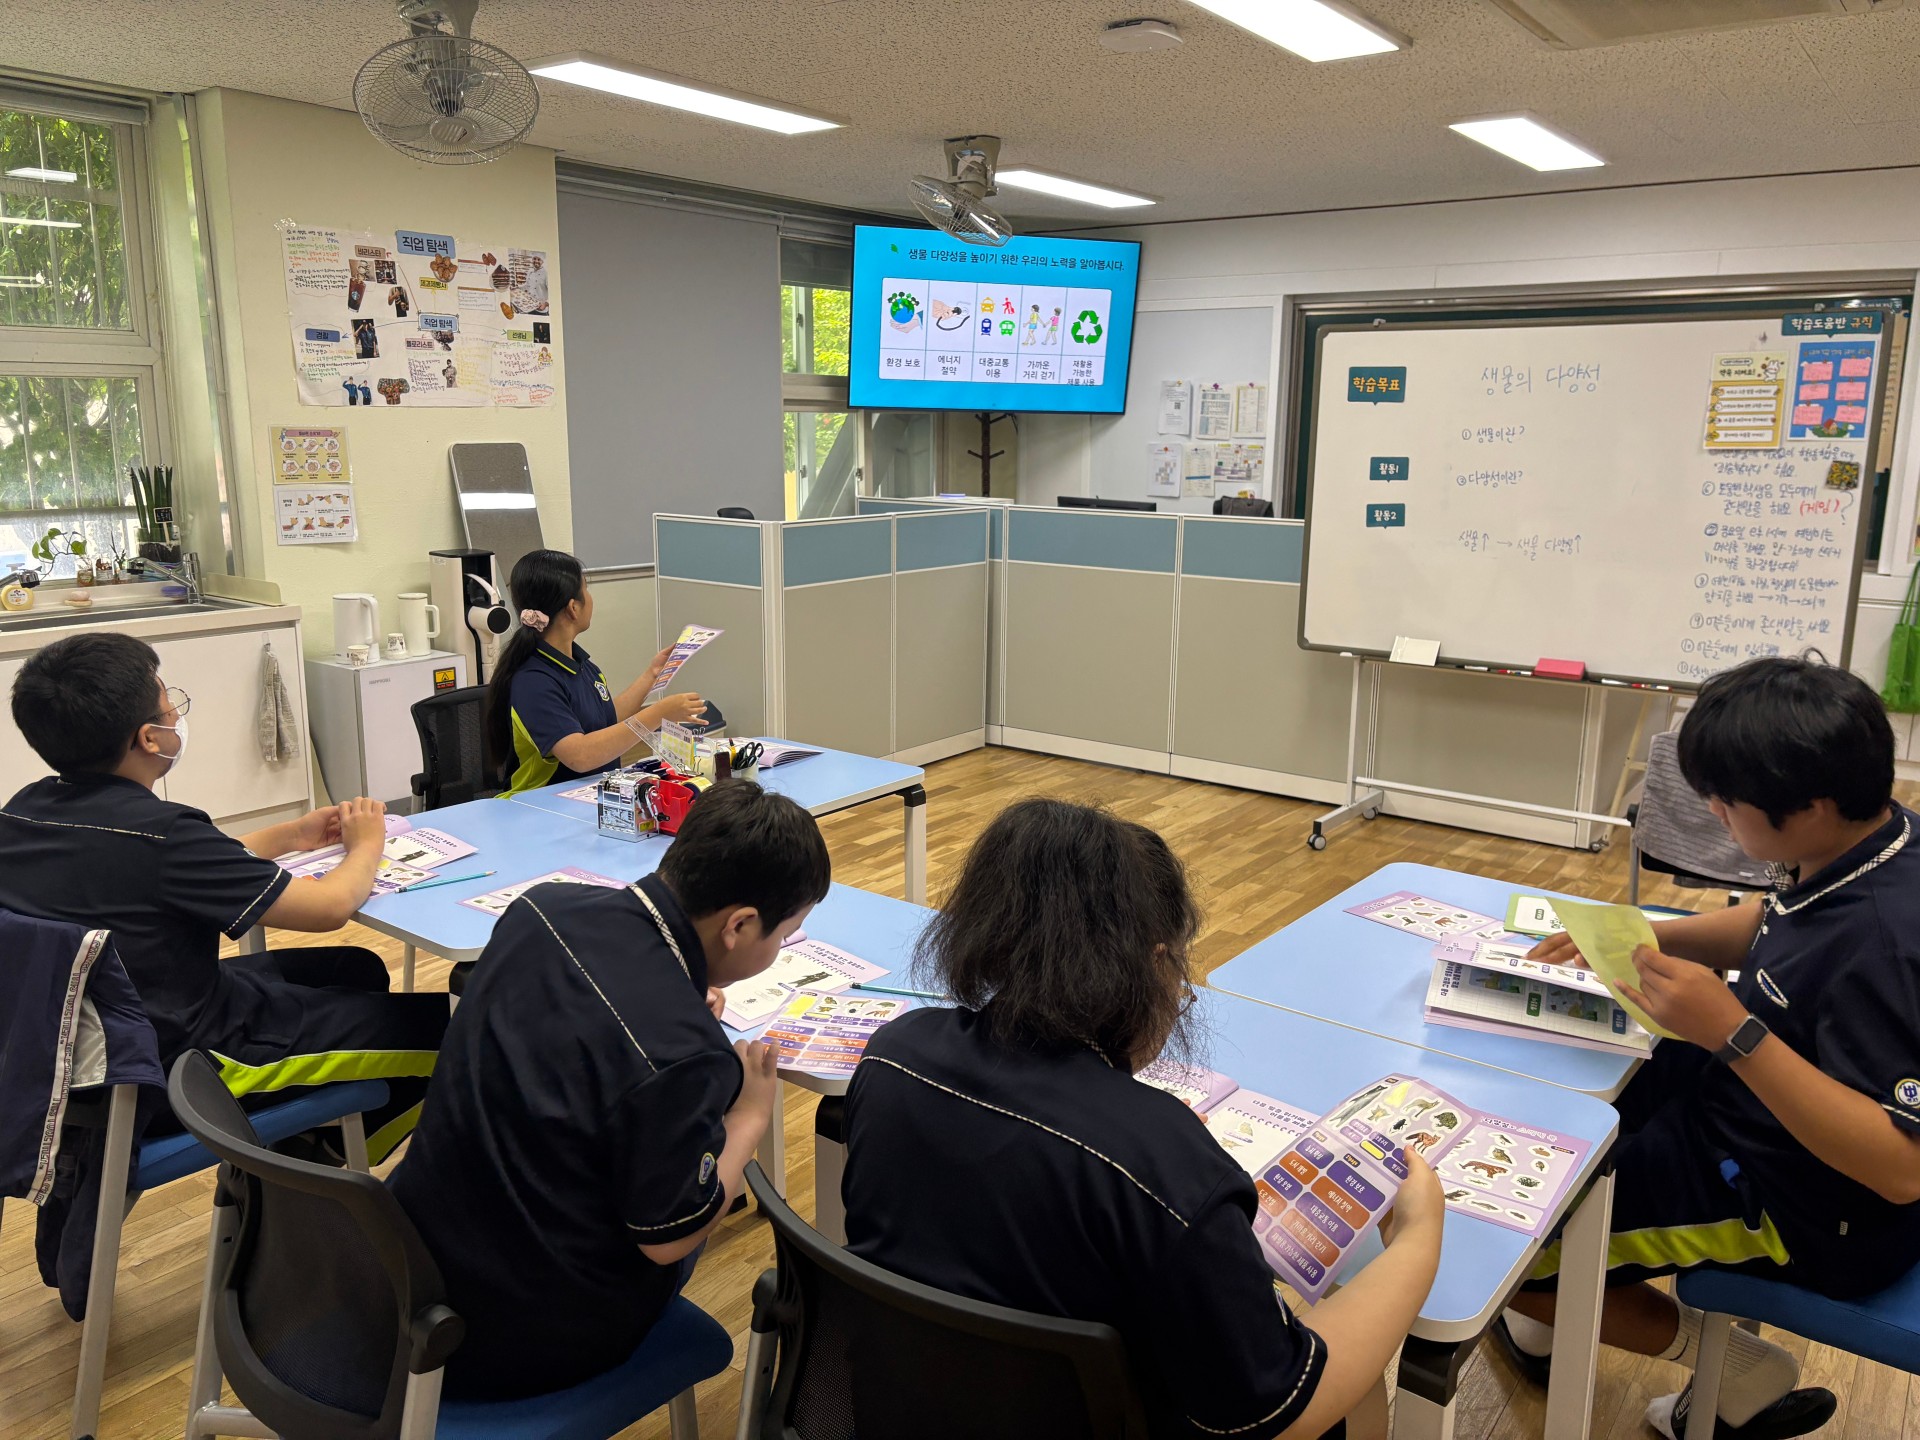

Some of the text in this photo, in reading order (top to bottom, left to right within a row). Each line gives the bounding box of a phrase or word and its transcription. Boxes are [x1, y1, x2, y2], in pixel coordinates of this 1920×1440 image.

[402, 236, 449, 254] 직업 탐색
[357, 248, 382, 258] 바리스타
[909, 249, 1124, 271] 생물 다양성을 높이기 위한 우리의 노력을 알아봅시다.
[424, 317, 453, 328] 직업 탐색
[1791, 316, 1874, 331] 학습도움반 규칙
[406, 340, 434, 349] 플로리스트
[886, 357, 921, 368] 환경 보호
[937, 355, 961, 366] 에너지
[978, 357, 1009, 368] 대중교통
[1027, 360, 1050, 370] 가까운
[1072, 360, 1093, 369] 재활용
[985, 368, 1001, 378] 이용
[1022, 370, 1055, 381] 거리 걷기
[1072, 368, 1093, 378] 가능한
[1353, 377, 1400, 393] 학습목표
[1481, 363, 1600, 396] 생물의 다양성
[1379, 463, 1399, 475] 활동1
[1374, 510, 1397, 522] 활동2
[1288, 1158, 1299, 1169] 도시
[1281, 1180, 1293, 1191] 오염
[1345, 1174, 1366, 1194] 환경 보호
[1257, 1188, 1268, 1199] 도로
[1327, 1190, 1344, 1205] 에너지
[1310, 1205, 1339, 1233] 대중교통 이용
[1305, 1232, 1318, 1244] 거리
[1297, 1256, 1309, 1269] 제품
[1306, 1266, 1319, 1280] 사용
